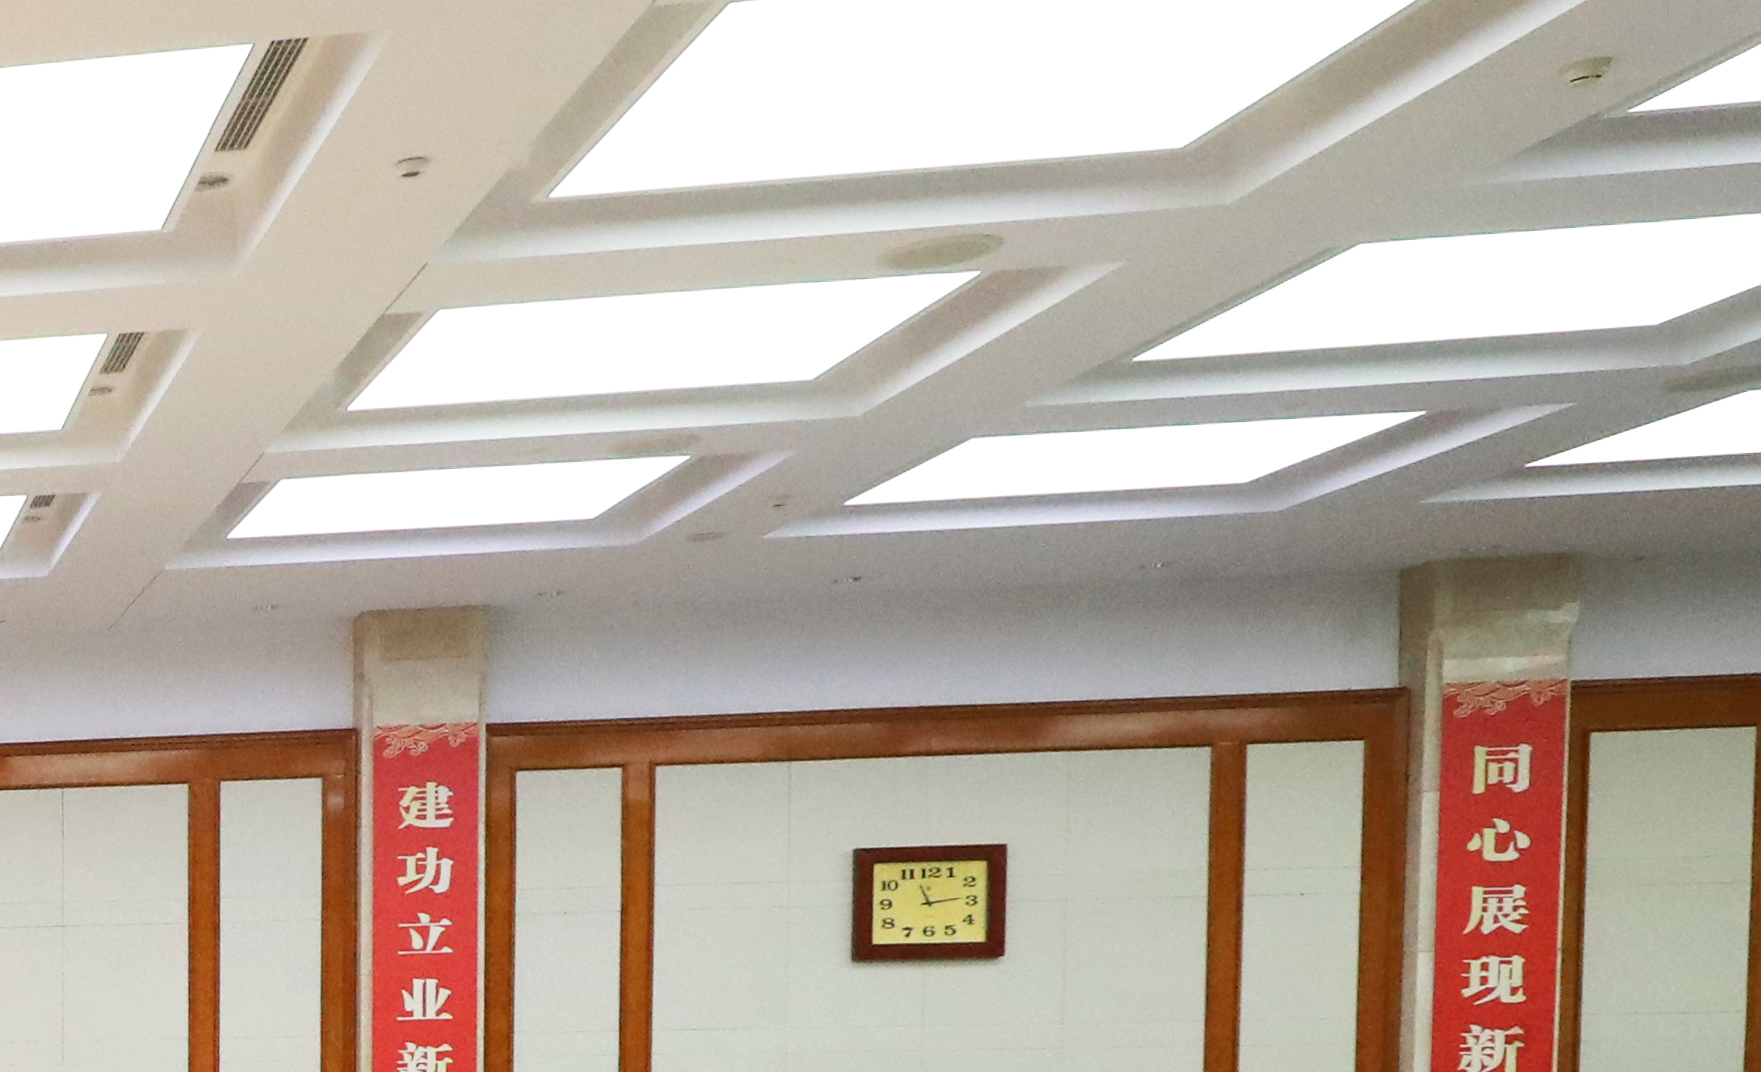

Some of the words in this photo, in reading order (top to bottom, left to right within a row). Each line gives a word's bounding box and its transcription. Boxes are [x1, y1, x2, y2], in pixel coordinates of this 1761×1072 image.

[901, 869, 915, 880] 11
[920, 867, 942, 879] 12
[946, 867, 956, 878] 1
[881, 880, 899, 891] 10
[963, 876, 977, 887] 2
[879, 899, 893, 910] 9
[965, 895, 978, 906] 3
[881, 918, 895, 929] 8
[962, 914, 975, 925] 4
[902, 927, 914, 938] 7
[923, 926, 936, 937] 6
[944, 925, 957, 936] 5
